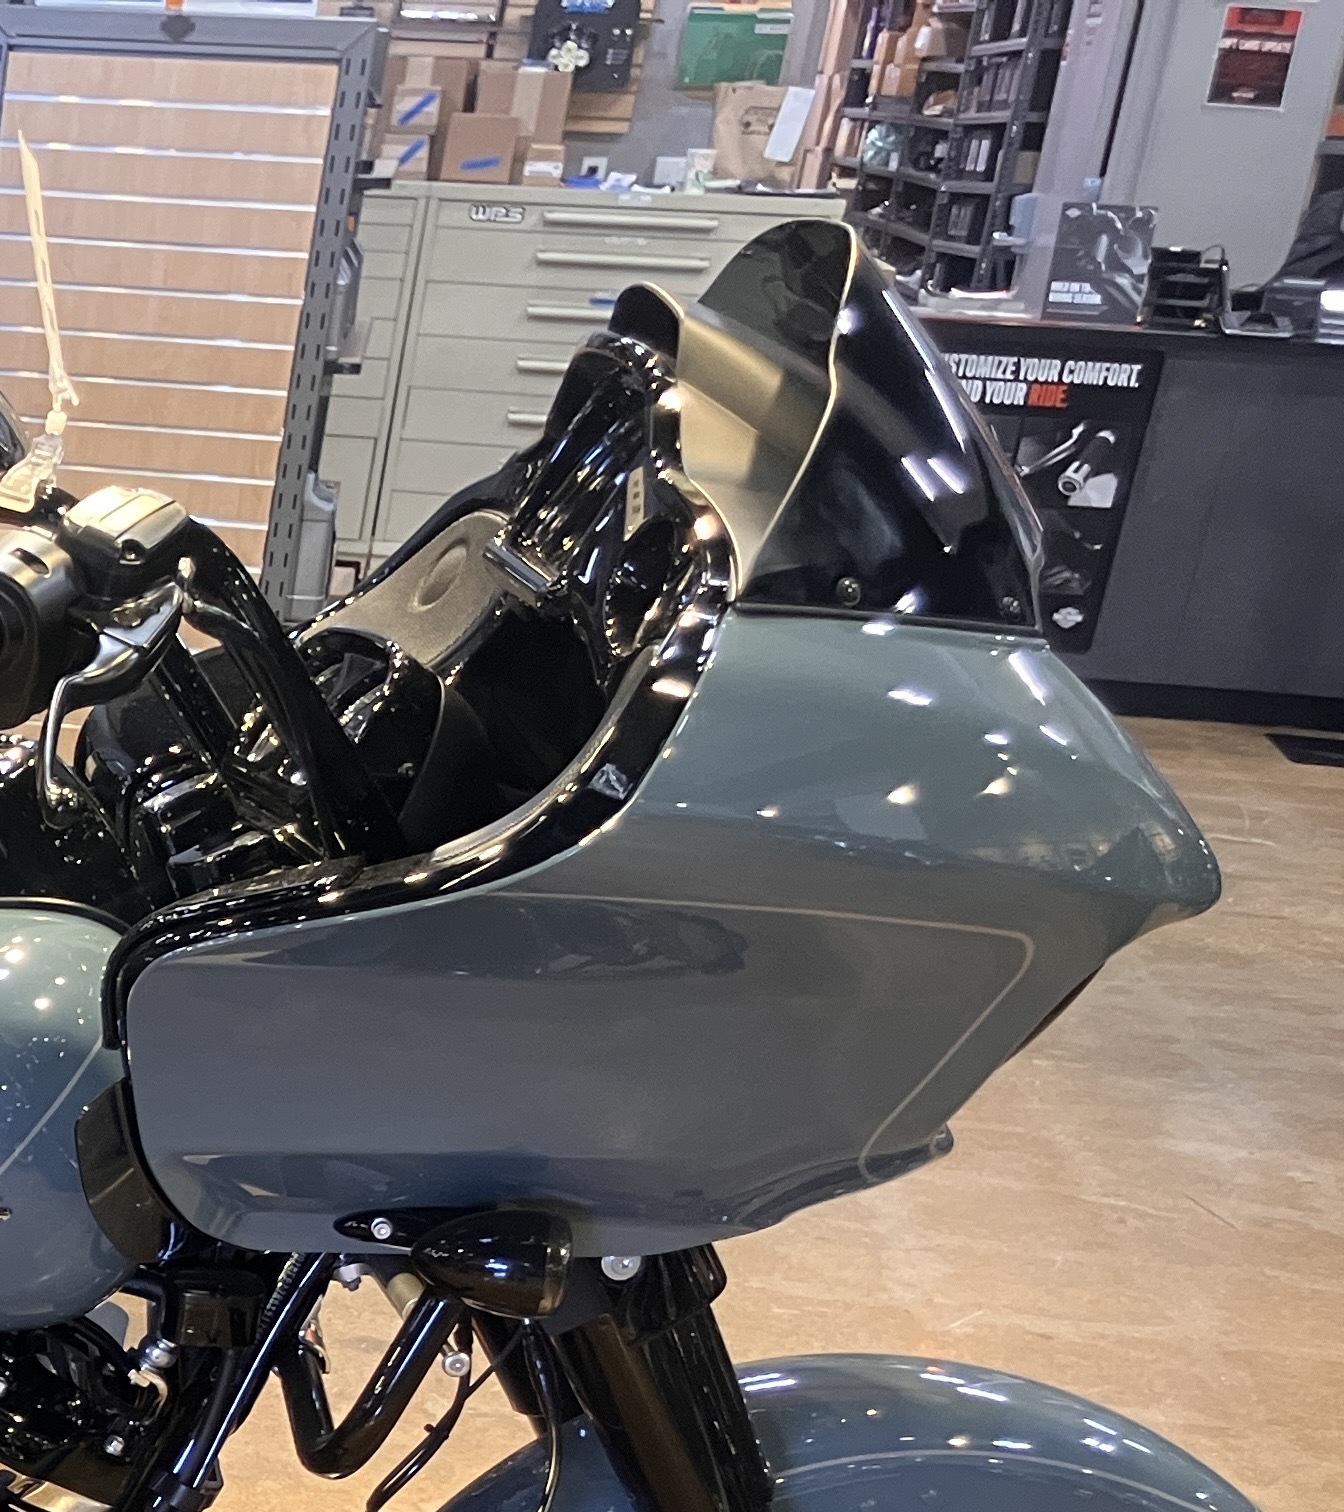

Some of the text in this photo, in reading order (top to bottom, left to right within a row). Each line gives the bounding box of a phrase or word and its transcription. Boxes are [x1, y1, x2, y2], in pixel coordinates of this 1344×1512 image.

[944, 353, 1143, 388] STOMIZE YOUR COMFORT.
[984, 380, 1028, 406] YOUR
